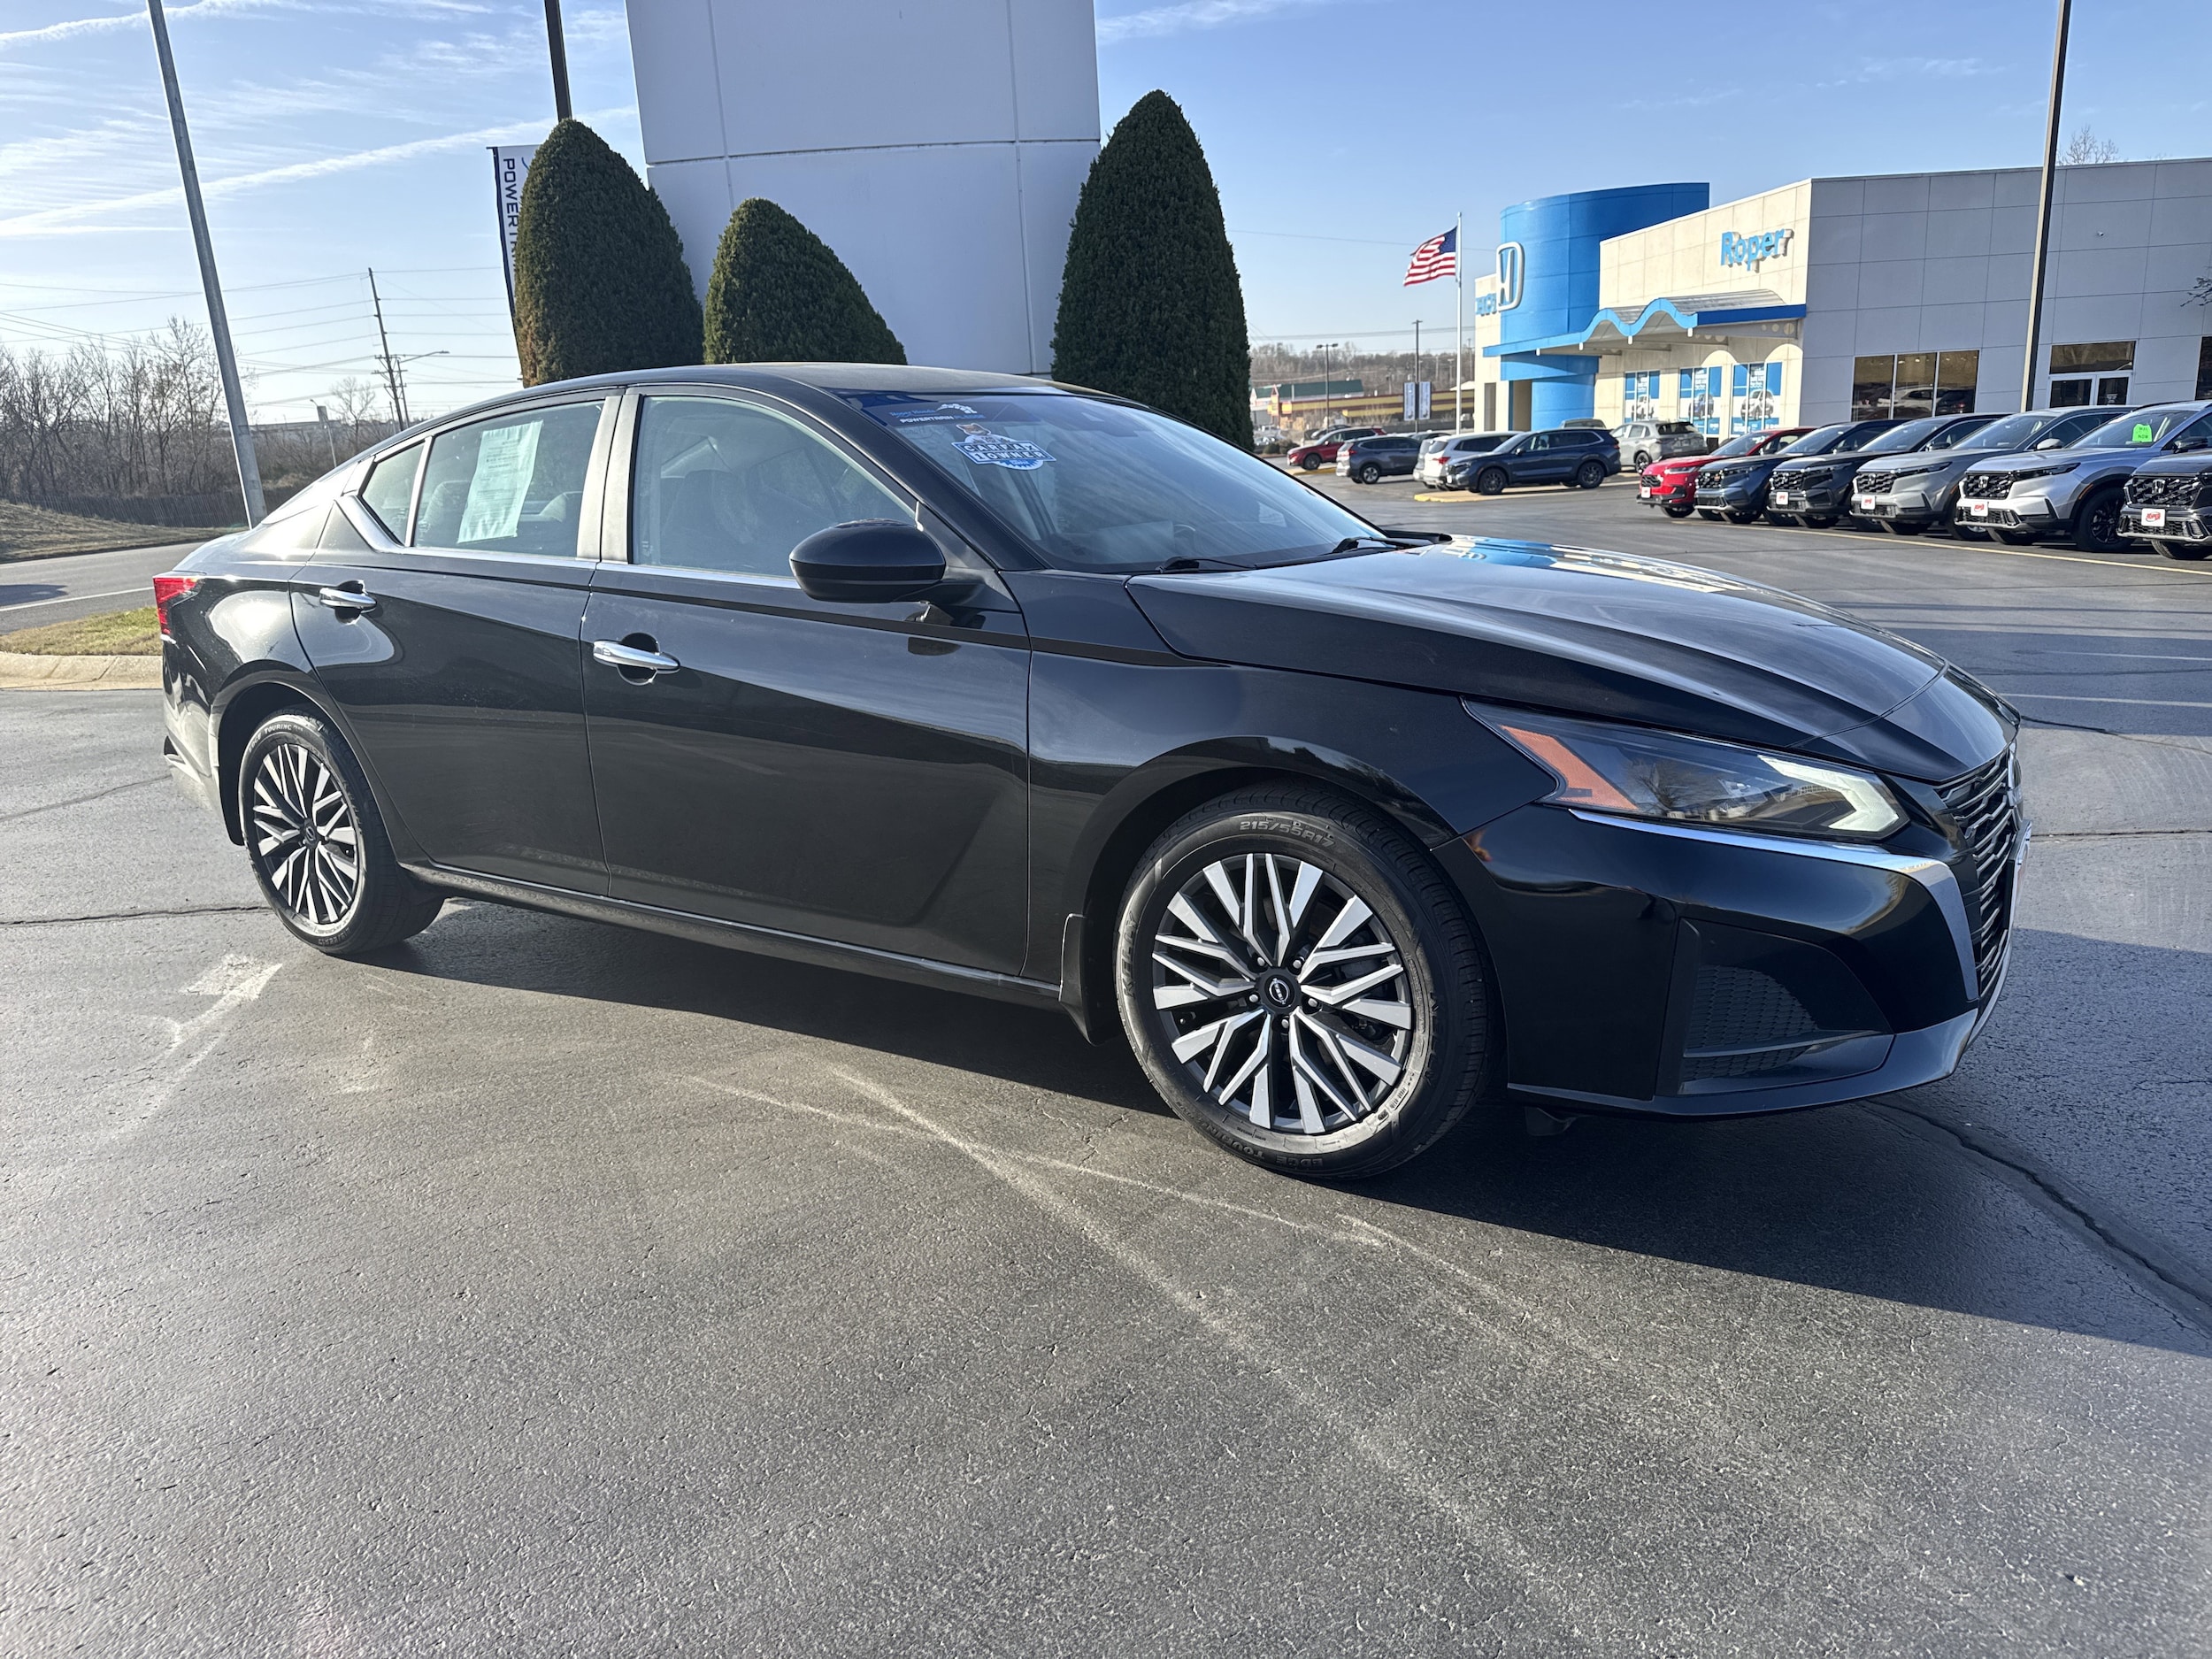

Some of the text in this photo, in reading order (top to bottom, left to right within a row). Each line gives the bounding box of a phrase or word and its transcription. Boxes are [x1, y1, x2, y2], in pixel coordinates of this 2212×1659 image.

[1720, 228, 1786, 272] Roper
[964, 443, 1039, 452] CARFAX
[1239, 820, 1335, 848] 215/55R17
[1121, 910, 1137, 1000] KELLY
[1276, 1156, 1324, 1167] EDGE
